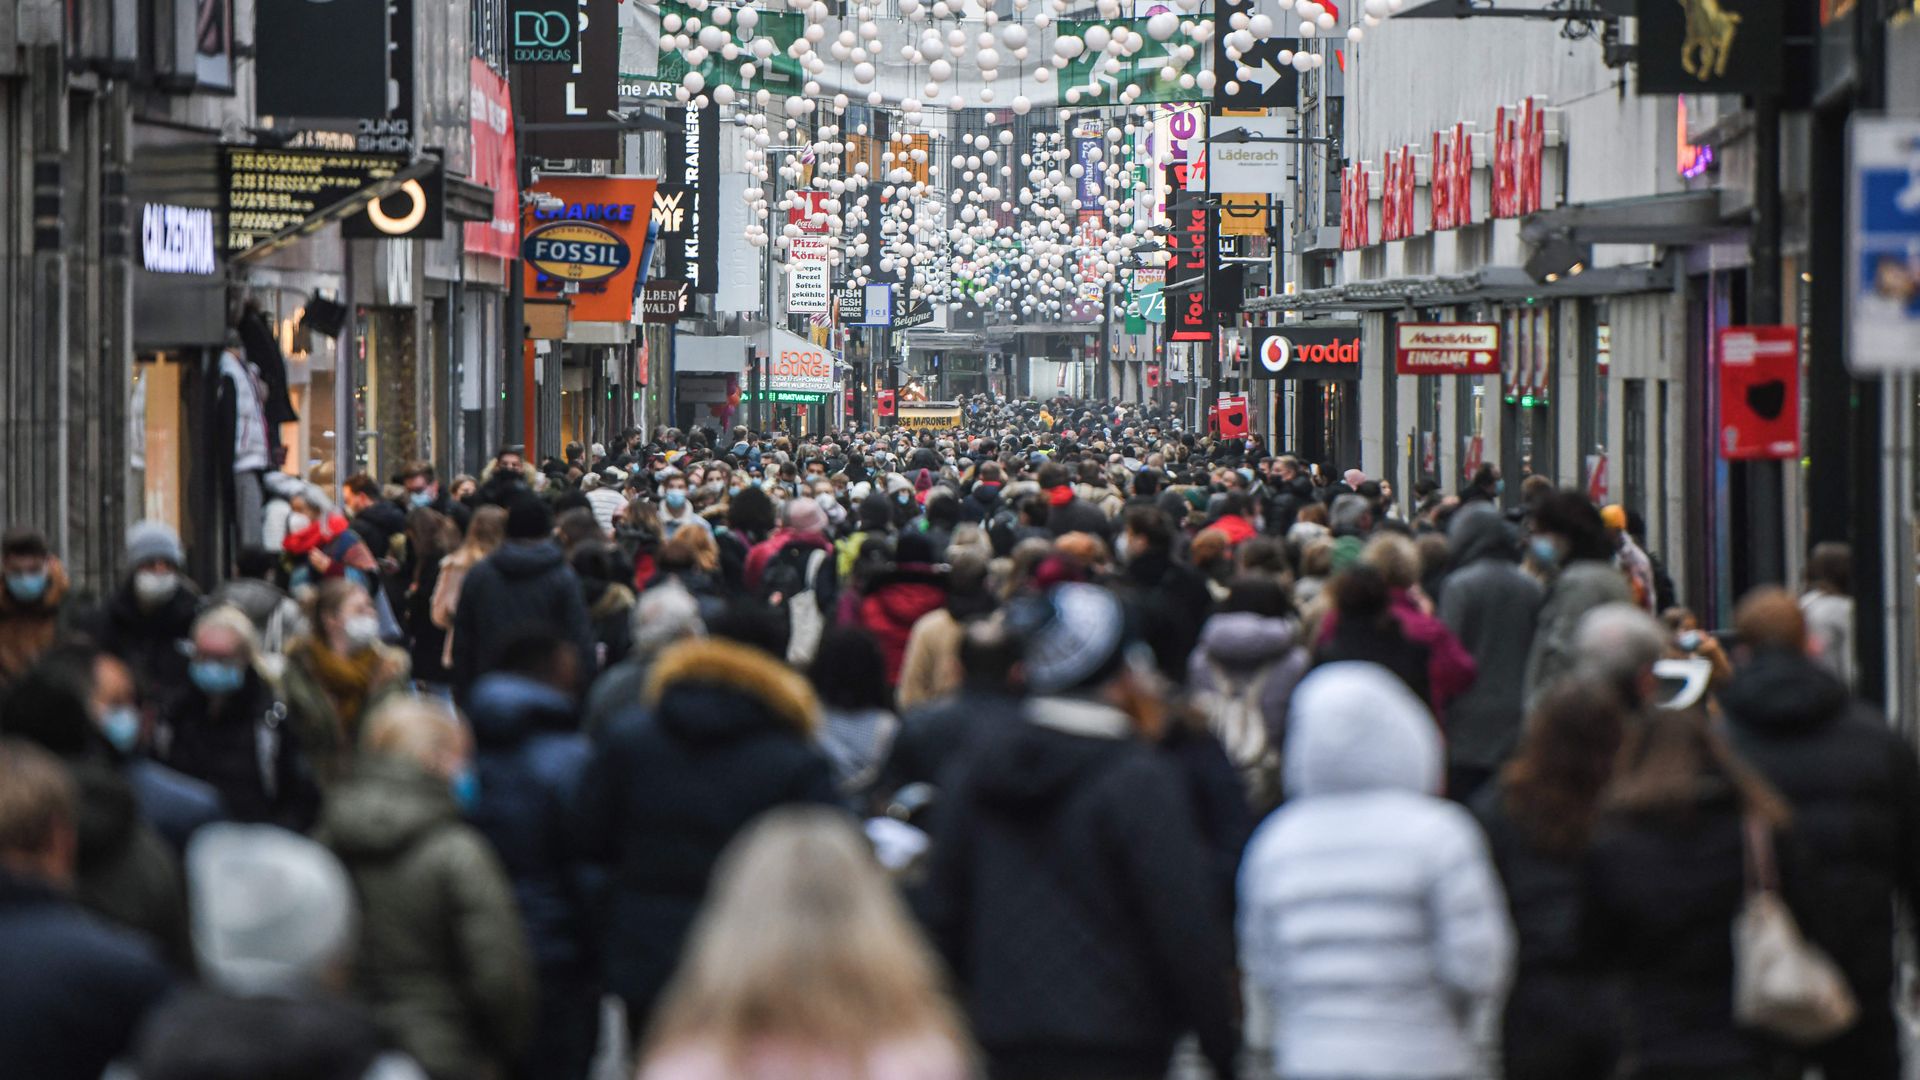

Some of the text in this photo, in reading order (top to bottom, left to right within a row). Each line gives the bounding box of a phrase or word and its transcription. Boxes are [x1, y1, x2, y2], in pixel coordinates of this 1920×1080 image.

[515, 50, 571, 61] DOUGLAS
[1218, 148, 1278, 160] Läderach
[535, 241, 620, 265] FOSSIL
[831, 289, 862, 298] USH
[642, 303, 676, 314] WALD
[893, 310, 932, 327] Belgique
[1297, 338, 1360, 363] vodaf
[781, 351, 823, 364] FOOD
[1407, 351, 1468, 366] EINGANG
[773, 363, 830, 377] LOUNGE
[778, 392, 820, 402] BRATWURST
[913, 416, 952, 426] MARONEN
